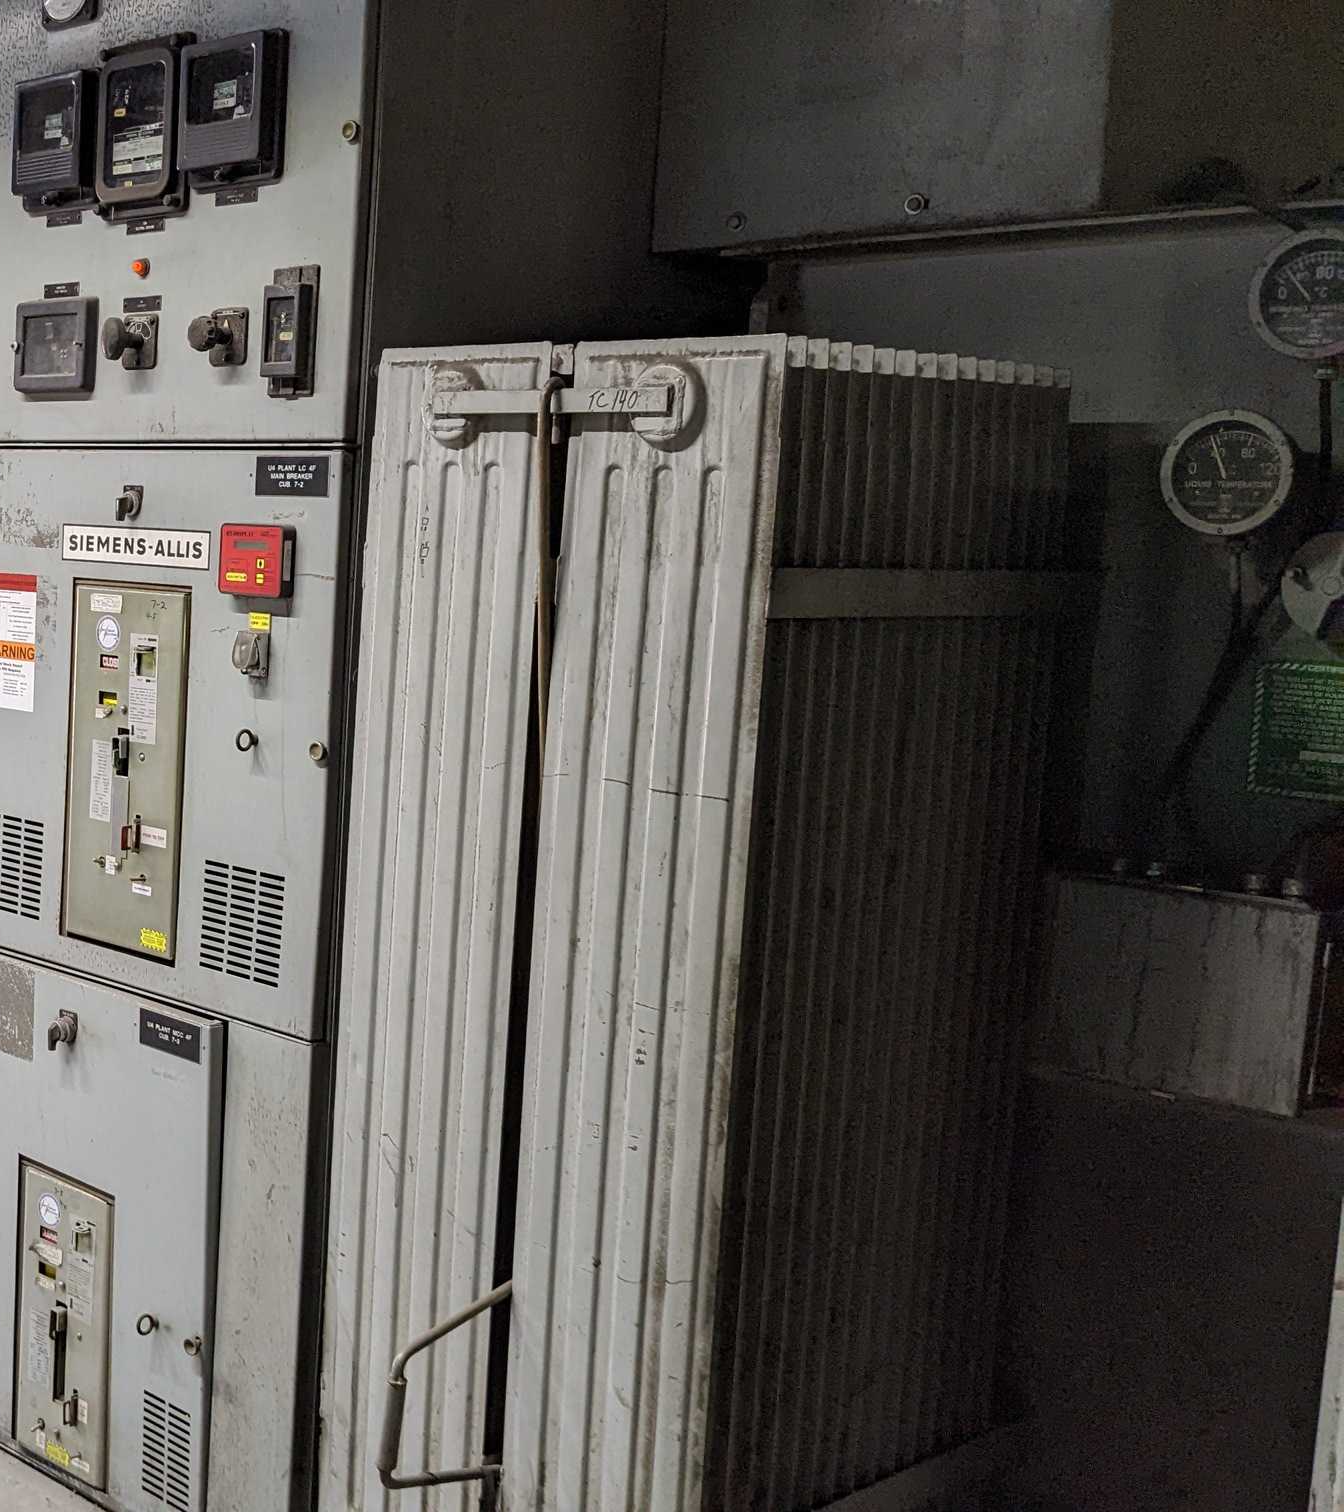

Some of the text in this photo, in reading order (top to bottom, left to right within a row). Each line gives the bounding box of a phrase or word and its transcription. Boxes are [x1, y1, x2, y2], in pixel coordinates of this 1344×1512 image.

[588, 389, 638, 412] TC 140
[286, 472, 313, 480] BREAKER
[68, 534, 203, 560] SIEMENS-ALLIS
[150, 599, 168, 610] 7-2
